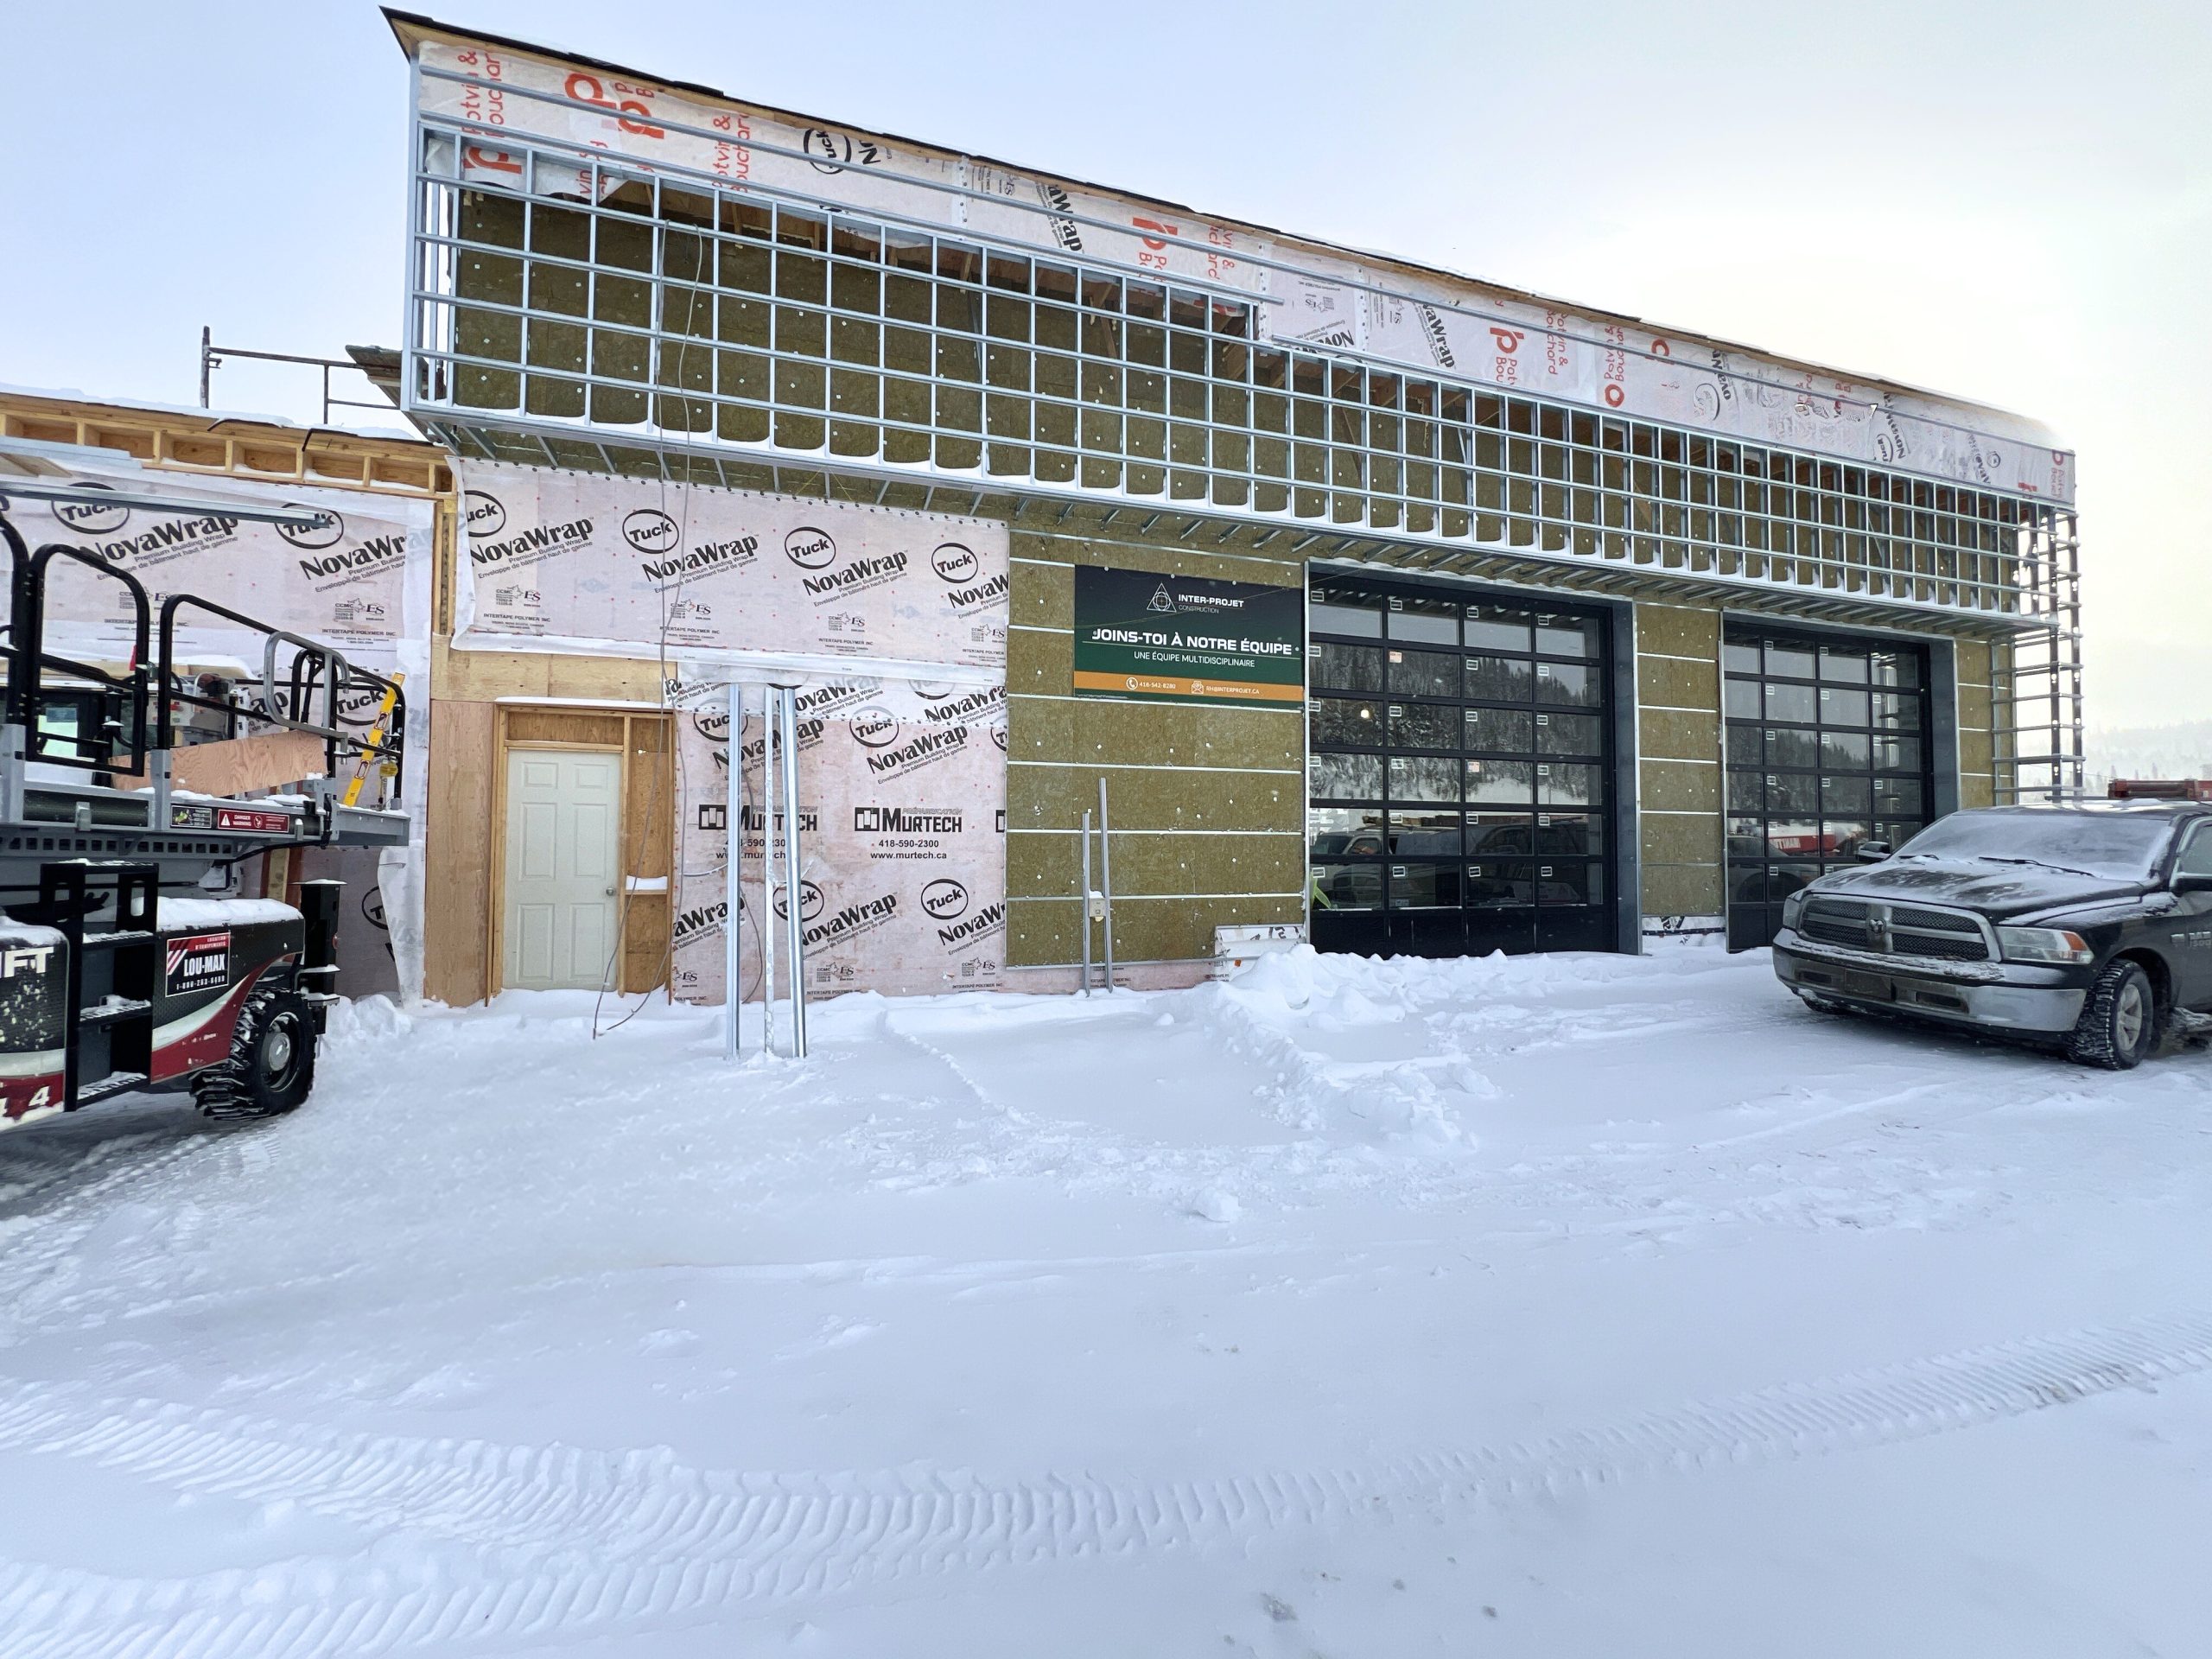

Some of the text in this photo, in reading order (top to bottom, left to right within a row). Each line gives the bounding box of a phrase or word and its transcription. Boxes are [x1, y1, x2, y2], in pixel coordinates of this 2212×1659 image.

[458, 52, 478, 65] &
[714, 115, 730, 130] &
[61, 503, 120, 522] Tuc
[467, 504, 499, 523] uck
[470, 518, 594, 567] NovaWrap
[629, 521, 672, 543] Tuck
[135, 533, 226, 563] Premium Building Wrap
[138, 561, 149, 569] de
[182, 546, 200, 557] haut
[211, 536, 238, 550] gamme
[299, 534, 408, 581] NovaWr
[509, 537, 583, 563] Premium Building Wrap
[642, 535, 759, 582] NovaWrap
[791, 538, 830, 558] Tuck
[348, 562, 380, 575] Premium
[478, 566, 511, 579] Enveloppe
[548, 550, 563, 558] haut
[570, 540, 594, 553] gamme
[682, 554, 748, 579] Premium Building Wrap
[937, 554, 973, 574] Tuck
[654, 581, 684, 594] Enveloppe
[717, 565, 730, 575] haut
[738, 556, 759, 568] gamme
[802, 550, 908, 597] NovaWrap
[838, 569, 899, 593] Premium Building Wrap
[315, 577, 351, 593] Enveloppe
[813, 594, 841, 607] Enveloppe
[870, 580, 882, 588] haut
[889, 572, 908, 582] gamme
[1178, 594, 1244, 608] INTER-PROJET
[1179, 604, 1219, 613] CONSTRUCTION
[1092, 628, 1292, 655] JOINS-TOI À NOTRE ÉQUIPE
[1134, 651, 1255, 668] UNE ÉQUIPE MULTIDISCIPLINAIRE
[337, 690, 385, 715] Tuck
[812, 701, 837, 713] Premium
[837, 693, 860, 704] Building
[846, 699, 858, 708] haut
[865, 690, 884, 701] gamme
[957, 702, 1001, 722] Premium Building
[987, 708, 998, 716] haut
[805, 739, 824, 750] gamme
[867, 725, 969, 774] NovaWrap
[901, 742, 959, 769] Premium Building Wrap
[878, 772, 904, 785] Enveloppe
[932, 754, 944, 763] haut
[950, 745, 968, 756] gamme
[882, 807, 962, 832] MURTECH
[879, 839, 939, 848] 418-590-2300
[871, 851, 947, 860] www.murtech.ca
[779, 890, 818, 913] Tck
[926, 889, 963, 911] Tuck
[695, 922, 719, 936] Building
[827, 912, 888, 944] Premium Building Wrap
[183, 954, 225, 977] LOU-MAX
